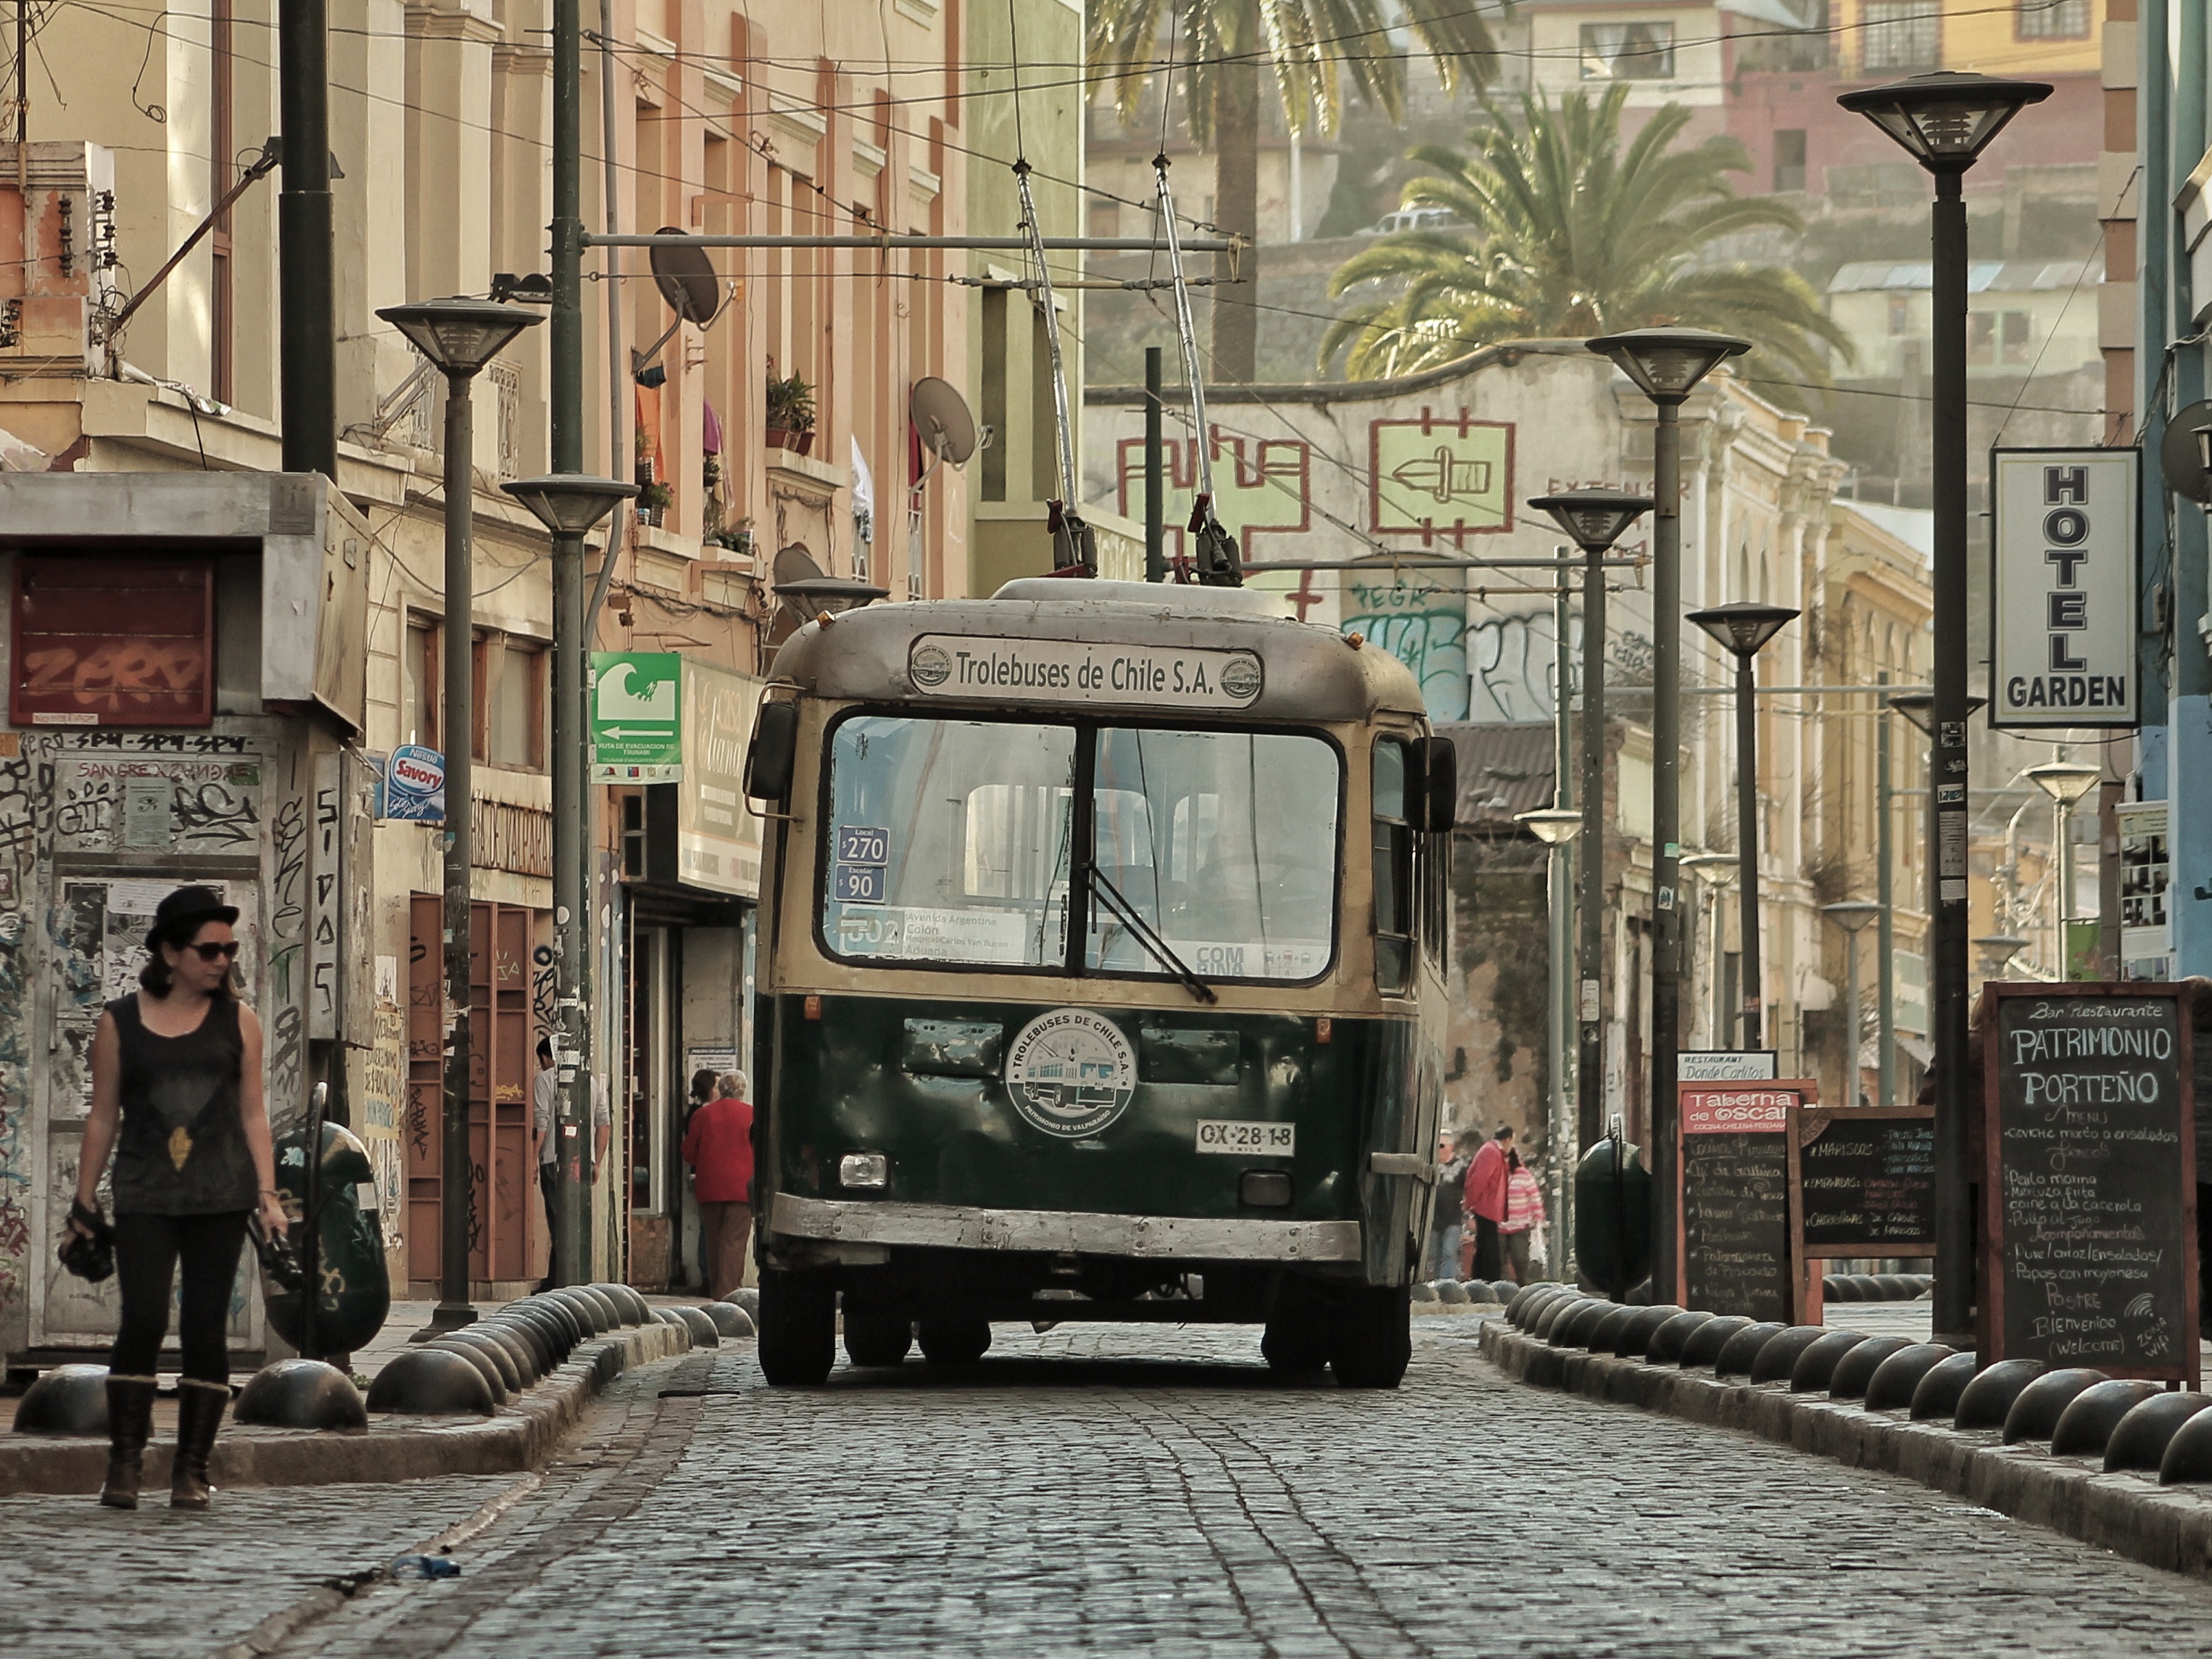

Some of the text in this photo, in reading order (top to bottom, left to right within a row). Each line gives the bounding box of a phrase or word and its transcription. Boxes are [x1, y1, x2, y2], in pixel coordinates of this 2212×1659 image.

[2043, 466, 2088, 673] HOTEL
[956, 651, 1070, 690] Trolebuses
[1077, 656, 1103, 690] de
[1111, 658, 1165, 692] Chile
[1172, 661, 1214, 695] S.A.
[2007, 676, 2125, 708] GARDEN
[77, 762, 151, 779] SANGRE
[396, 759, 442, 789] Savory
[907, 912, 996, 926] Avenida Argentina
[906, 924, 939, 935] Colón
[906, 945, 948, 956] Aduana
[1196, 947, 1245, 964] COM
[2029, 1001, 2163, 1019] Bar Restaurante
[1013, 1015, 1130, 1075] TROLEBUSES DE CHILE S.A.
[2010, 1027, 2171, 1065] PATRIMONIO
[1686, 1064, 1720, 1080] Donde
[2020, 1071, 2159, 1104] PORTEÑO
[1689, 1093, 1793, 1107] Taberna
[1024, 1104, 1061, 1130] PATRIMONIO
[1689, 1112, 1710, 1122] de
[2059, 1126, 2099, 1139] mixto
[2103, 1130, 2111, 1139] o
[2114, 1127, 2179, 1143] ensaladas
[2009, 1170, 2097, 1187] Paila marina
[2064, 1185, 2096, 1202] frita
[2009, 1197, 2142, 1212] carne a la cacerola
[2013, 1210, 2047, 1227] Pollo
[2050, 1210, 2066, 1225] al
[2016, 1262, 2149, 1287] Papas con mayonesa
